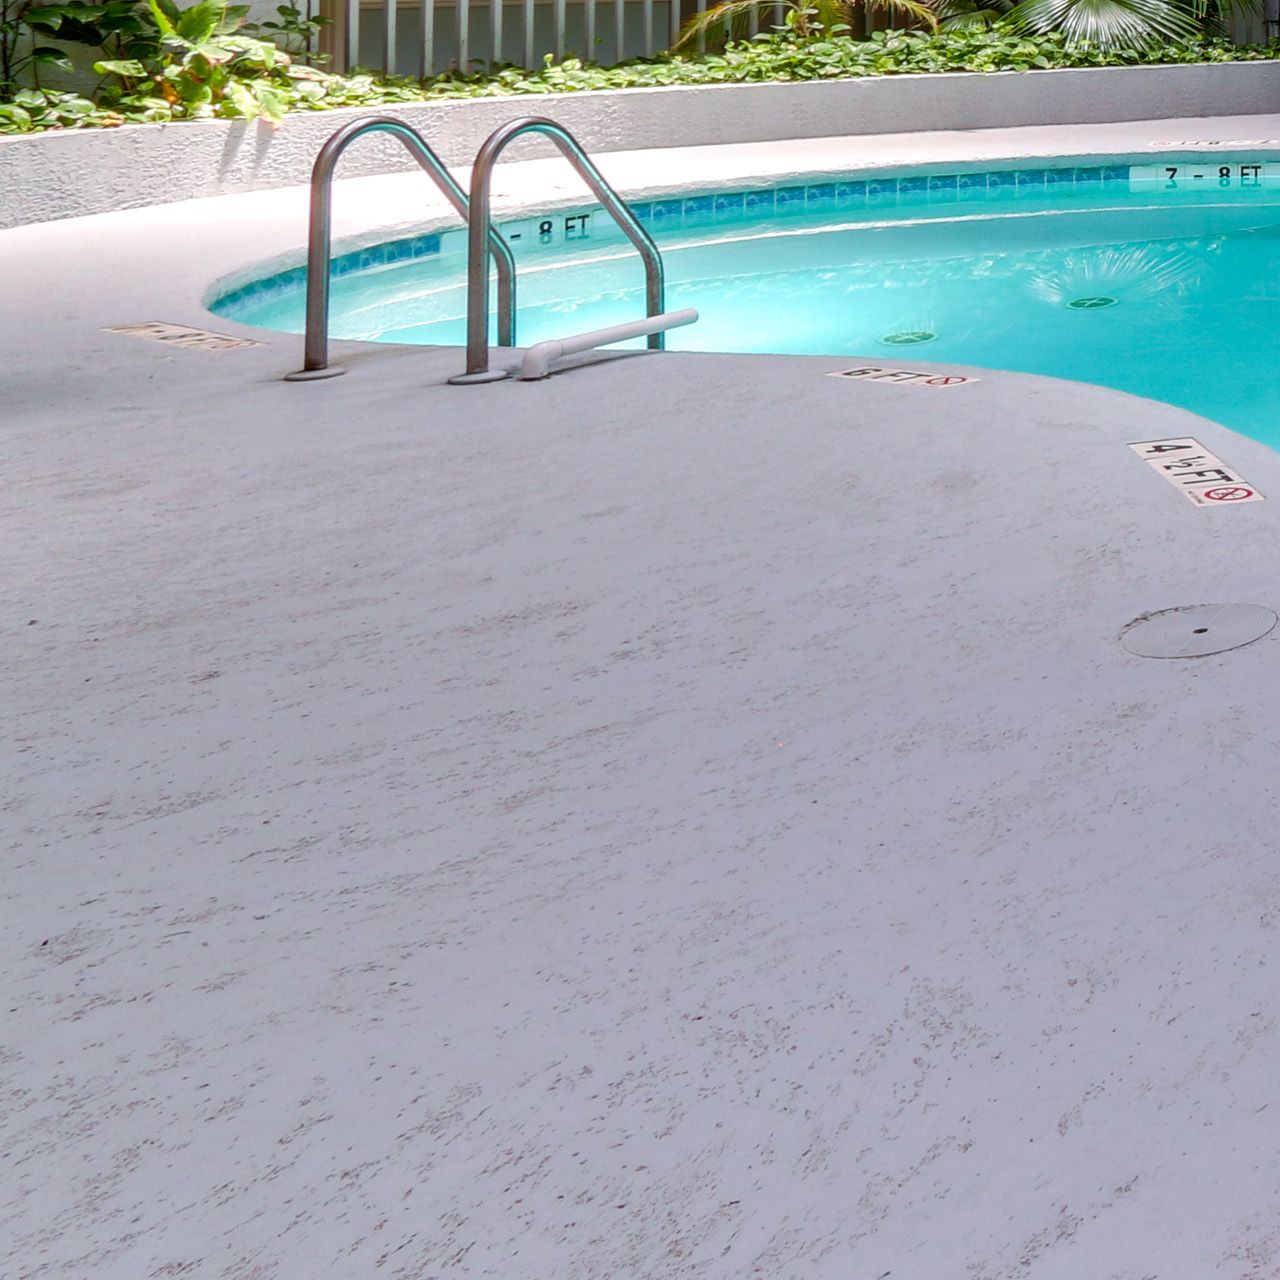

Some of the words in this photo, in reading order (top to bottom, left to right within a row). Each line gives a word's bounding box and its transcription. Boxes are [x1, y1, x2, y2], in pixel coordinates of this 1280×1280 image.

[1165, 167, 1178, 180] 7
[1218, 166, 1230, 178] 8
[1240, 166, 1262, 178] FT
[564, 214, 590, 231] FT
[871, 371, 935, 382] FT
[1146, 444, 1193, 453] 4
[1172, 468, 1235, 485] FT
